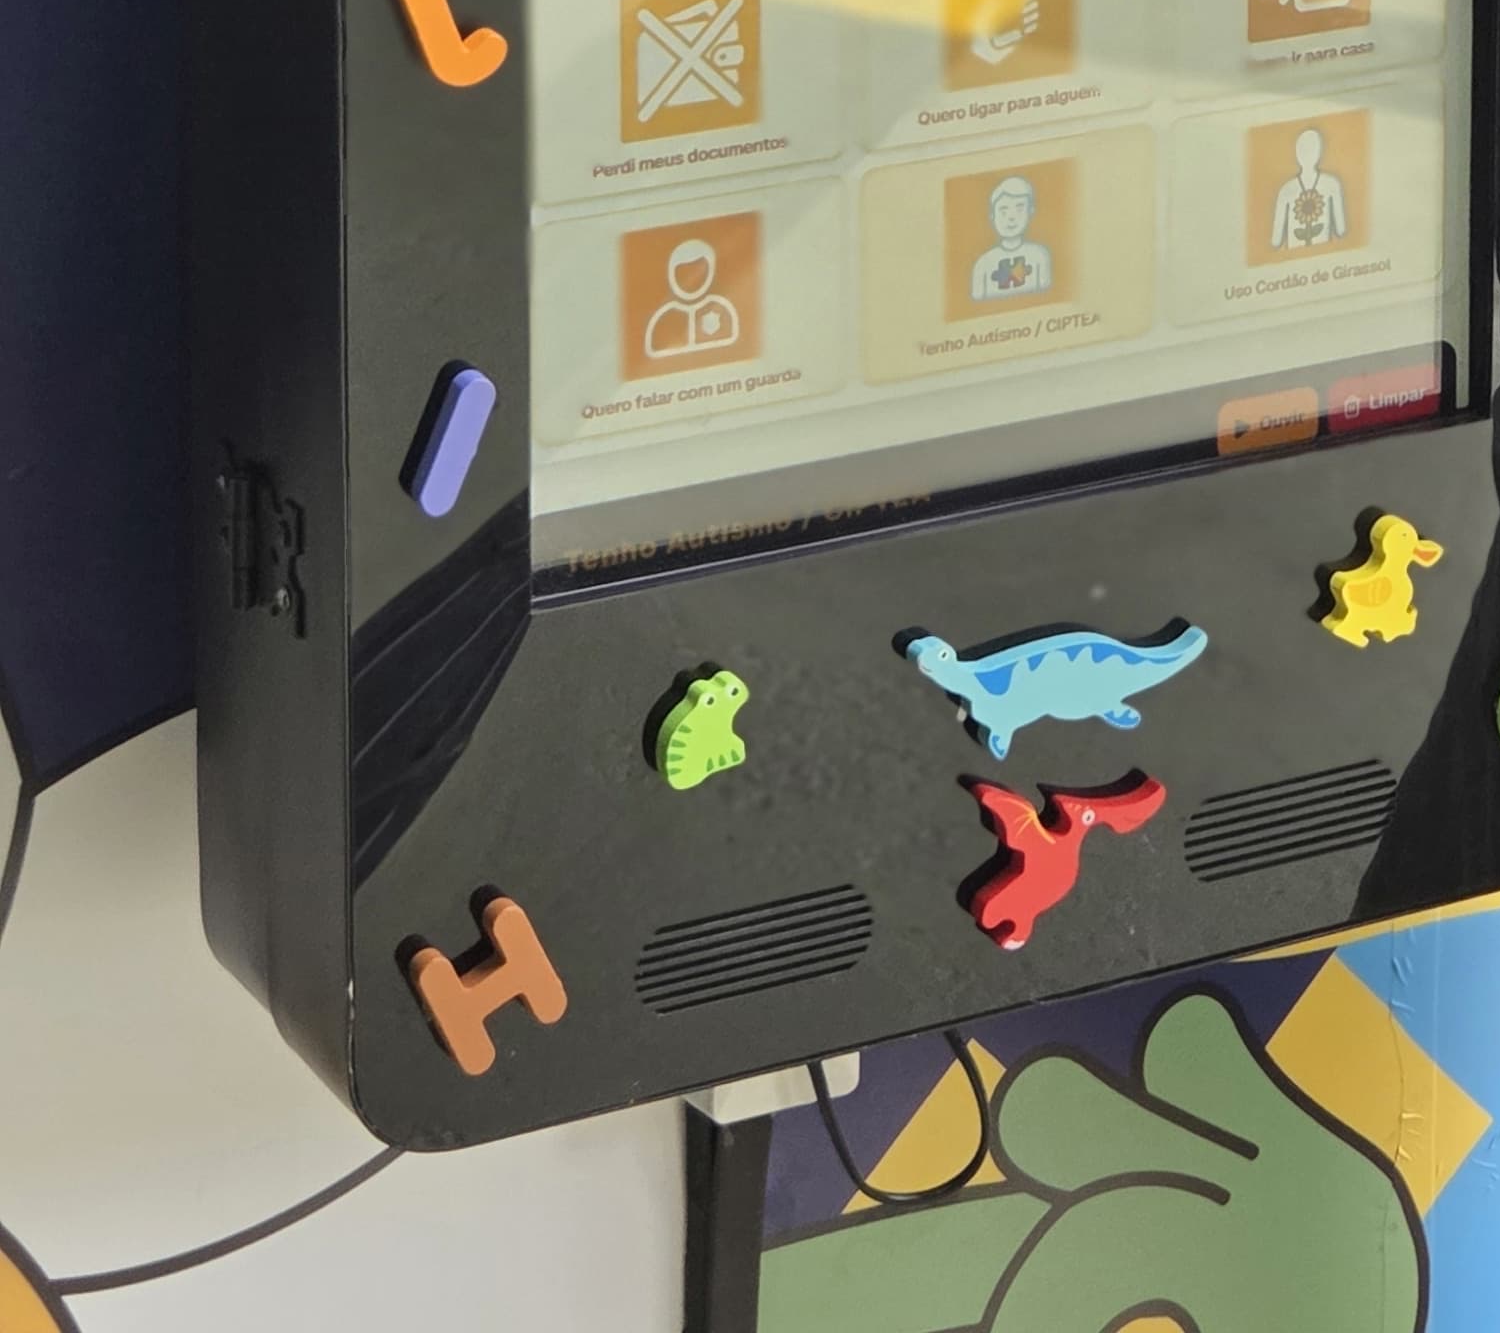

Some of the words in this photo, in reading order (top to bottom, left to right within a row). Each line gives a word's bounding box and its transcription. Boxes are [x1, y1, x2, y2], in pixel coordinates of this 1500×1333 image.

[1341, 41, 1375, 56] casa
[918, 108, 966, 126] Quero
[969, 101, 1003, 119] ligar
[1007, 95, 1042, 114] para
[592, 158, 635, 178] Perdi
[639, 153, 684, 172] meus
[687, 137, 788, 164] documentos
[1224, 284, 1252, 301] Uso
[1256, 273, 1308, 294] Cordão
[1311, 269, 1329, 284] de
[1332, 258, 1391, 280] Girassol
[968, 326, 1031, 348] Autismo
[1034, 320, 1042, 338] /
[1045, 313, 1101, 333] CIPTEA
[581, 398, 632, 420] Quero
[635, 391, 674, 410] falar
[677, 384, 713, 401] com
[716, 380, 742, 396] um
[745, 369, 802, 393] guarda
[1369, 386, 1427, 411] Limpar
[412, 897, 568, 1076] H
